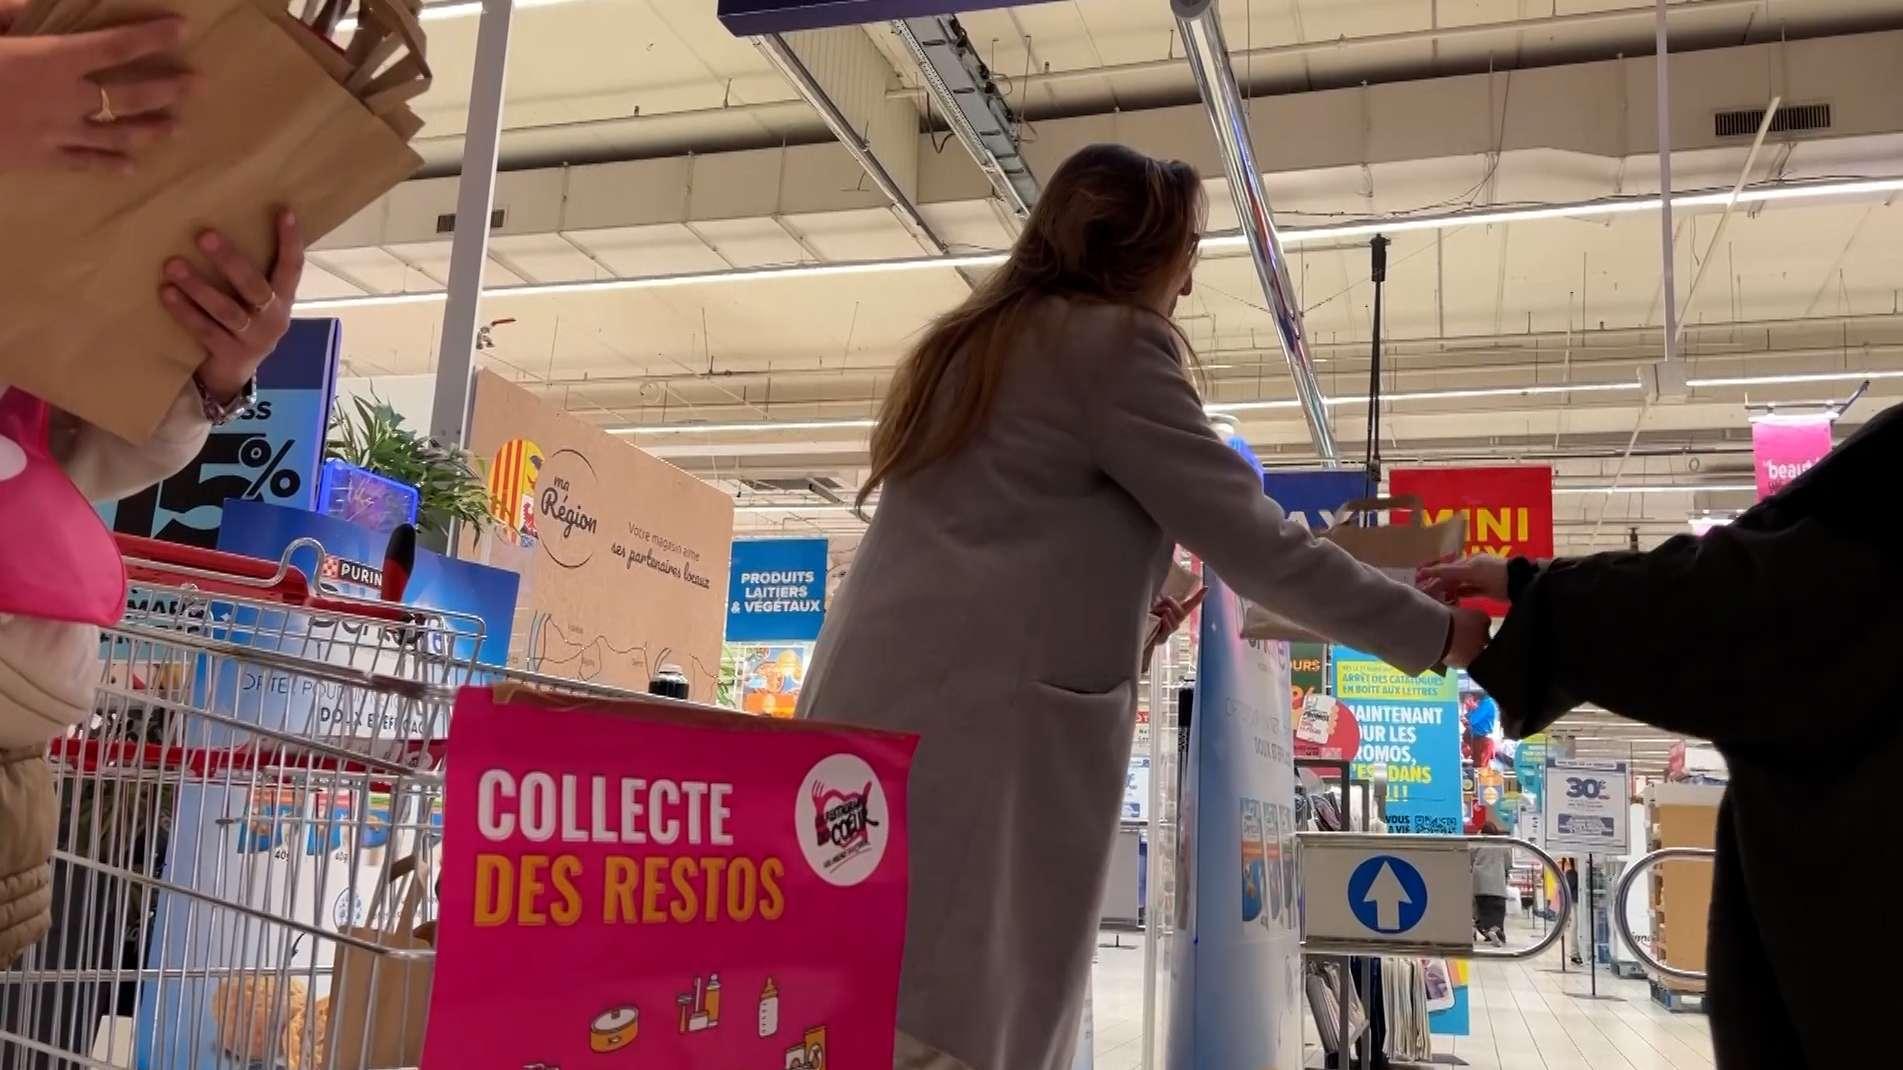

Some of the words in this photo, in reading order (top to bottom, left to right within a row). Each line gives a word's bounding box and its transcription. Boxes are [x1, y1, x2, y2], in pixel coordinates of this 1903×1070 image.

[554, 476, 570, 492] ma
[541, 487, 598, 538] Région
[629, 522, 650, 544] Votre
[652, 534, 682, 553] magasin
[683, 548, 700, 562] aime
[611, 543, 626, 558] ses
[627, 548, 681, 580] partenaires
[684, 562, 710, 589] locaux
[341, 565, 383, 587] PURIN
[740, 571, 815, 584] PRODUITS
[745, 586, 808, 598] LAITIERS
[731, 601, 741, 614] &
[744, 597, 821, 613] VÉGÉTAUX
[1371, 673, 1388, 684] DES
[1383, 686, 1401, 695] AUX
[1389, 725, 1416, 743] LES
[1388, 765, 1432, 784] DANS
[477, 768, 734, 845] COLLECTE
[474, 854, 583, 926] DES
[603, 855, 785, 925] RESTOS
